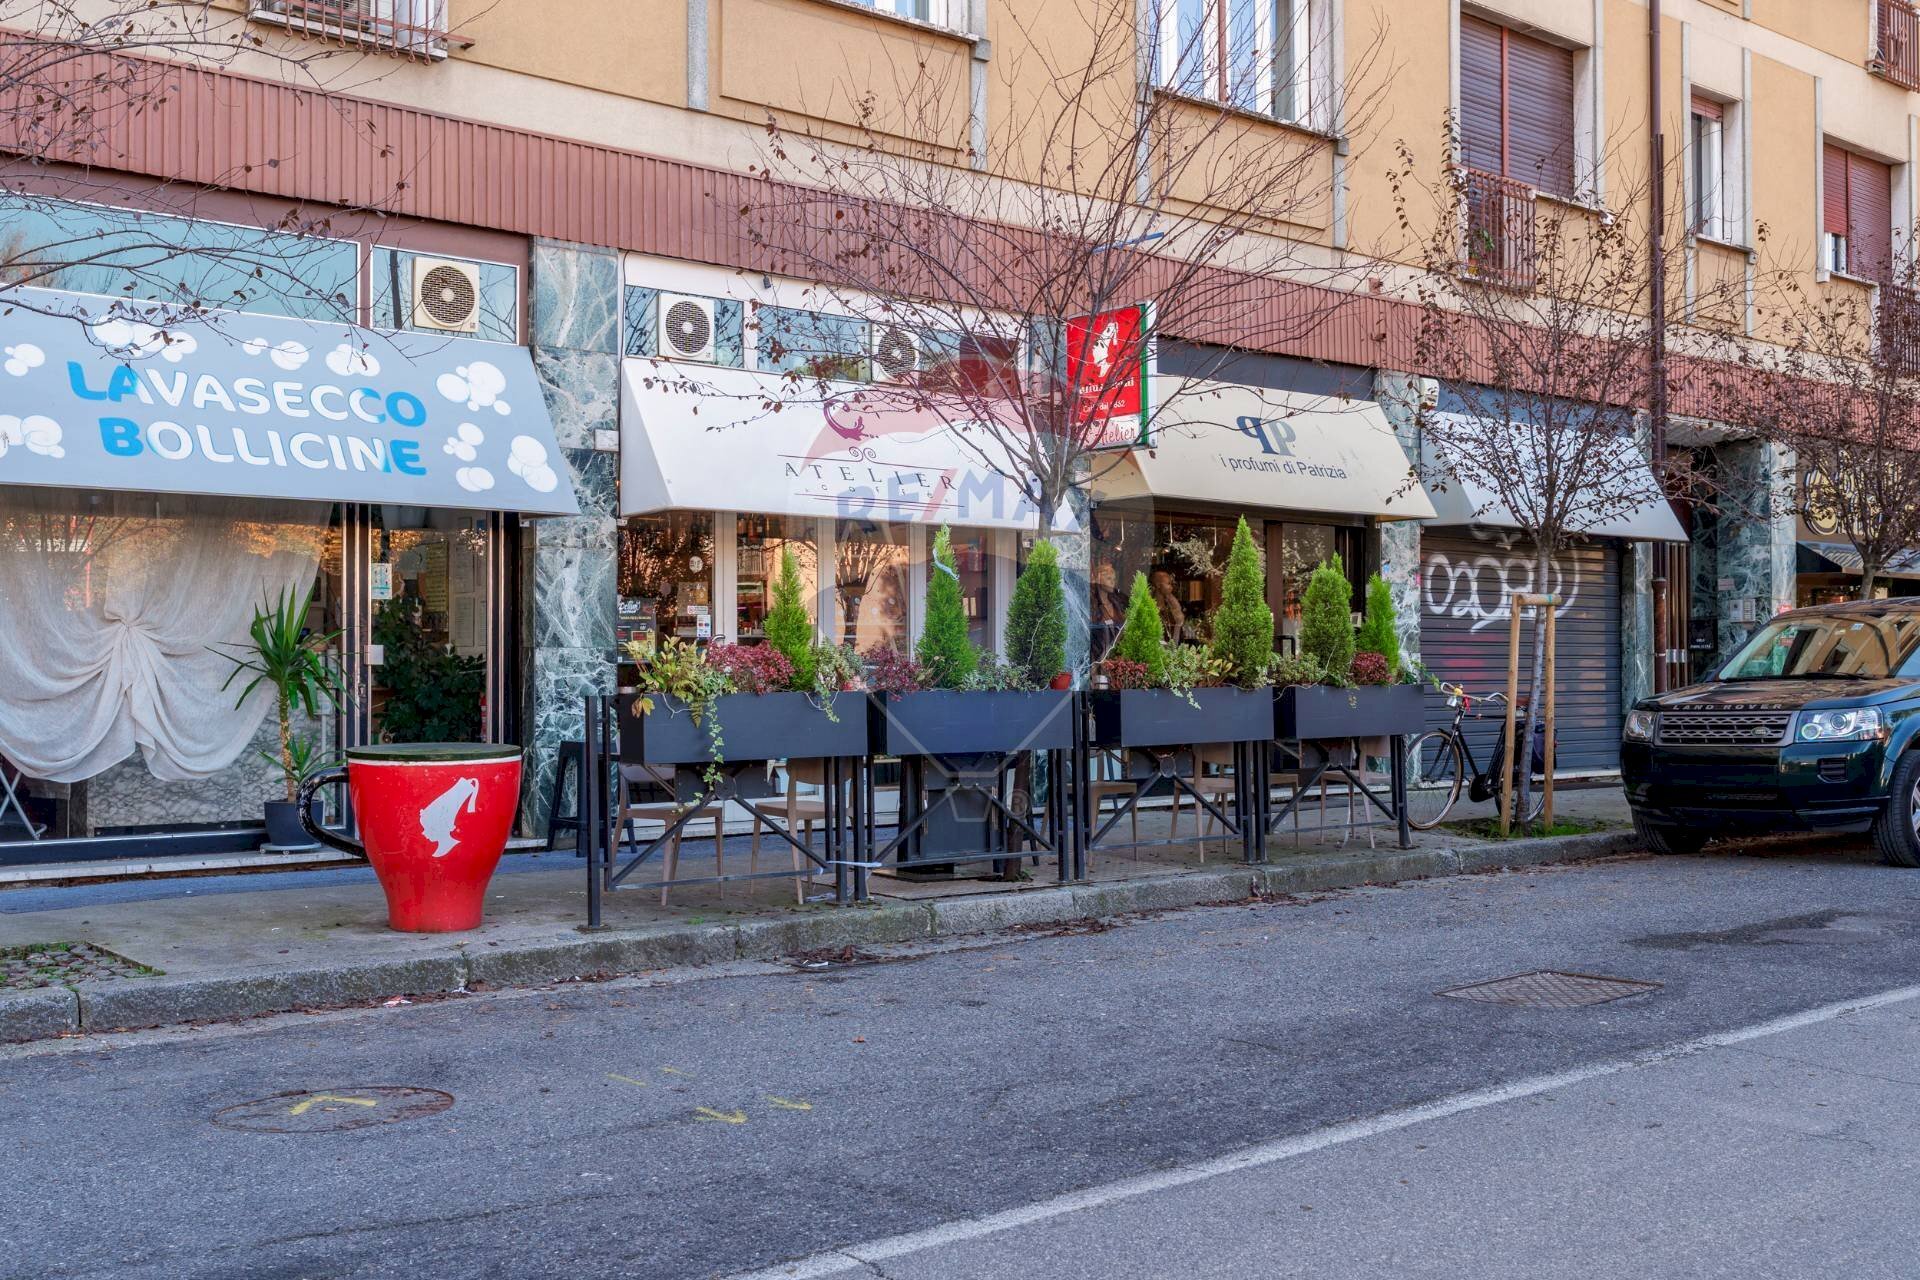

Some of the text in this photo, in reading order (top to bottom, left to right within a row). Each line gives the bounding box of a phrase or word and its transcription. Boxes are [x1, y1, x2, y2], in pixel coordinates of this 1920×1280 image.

[66, 360, 427, 427] LAVASECCO
[99, 417, 428, 477] BOLLICINE
[1229, 456, 1281, 472] profumi
[1283, 460, 1297, 475] di
[1297, 461, 1348, 480] Patrizia
[785, 462, 957, 491] ATELIER
